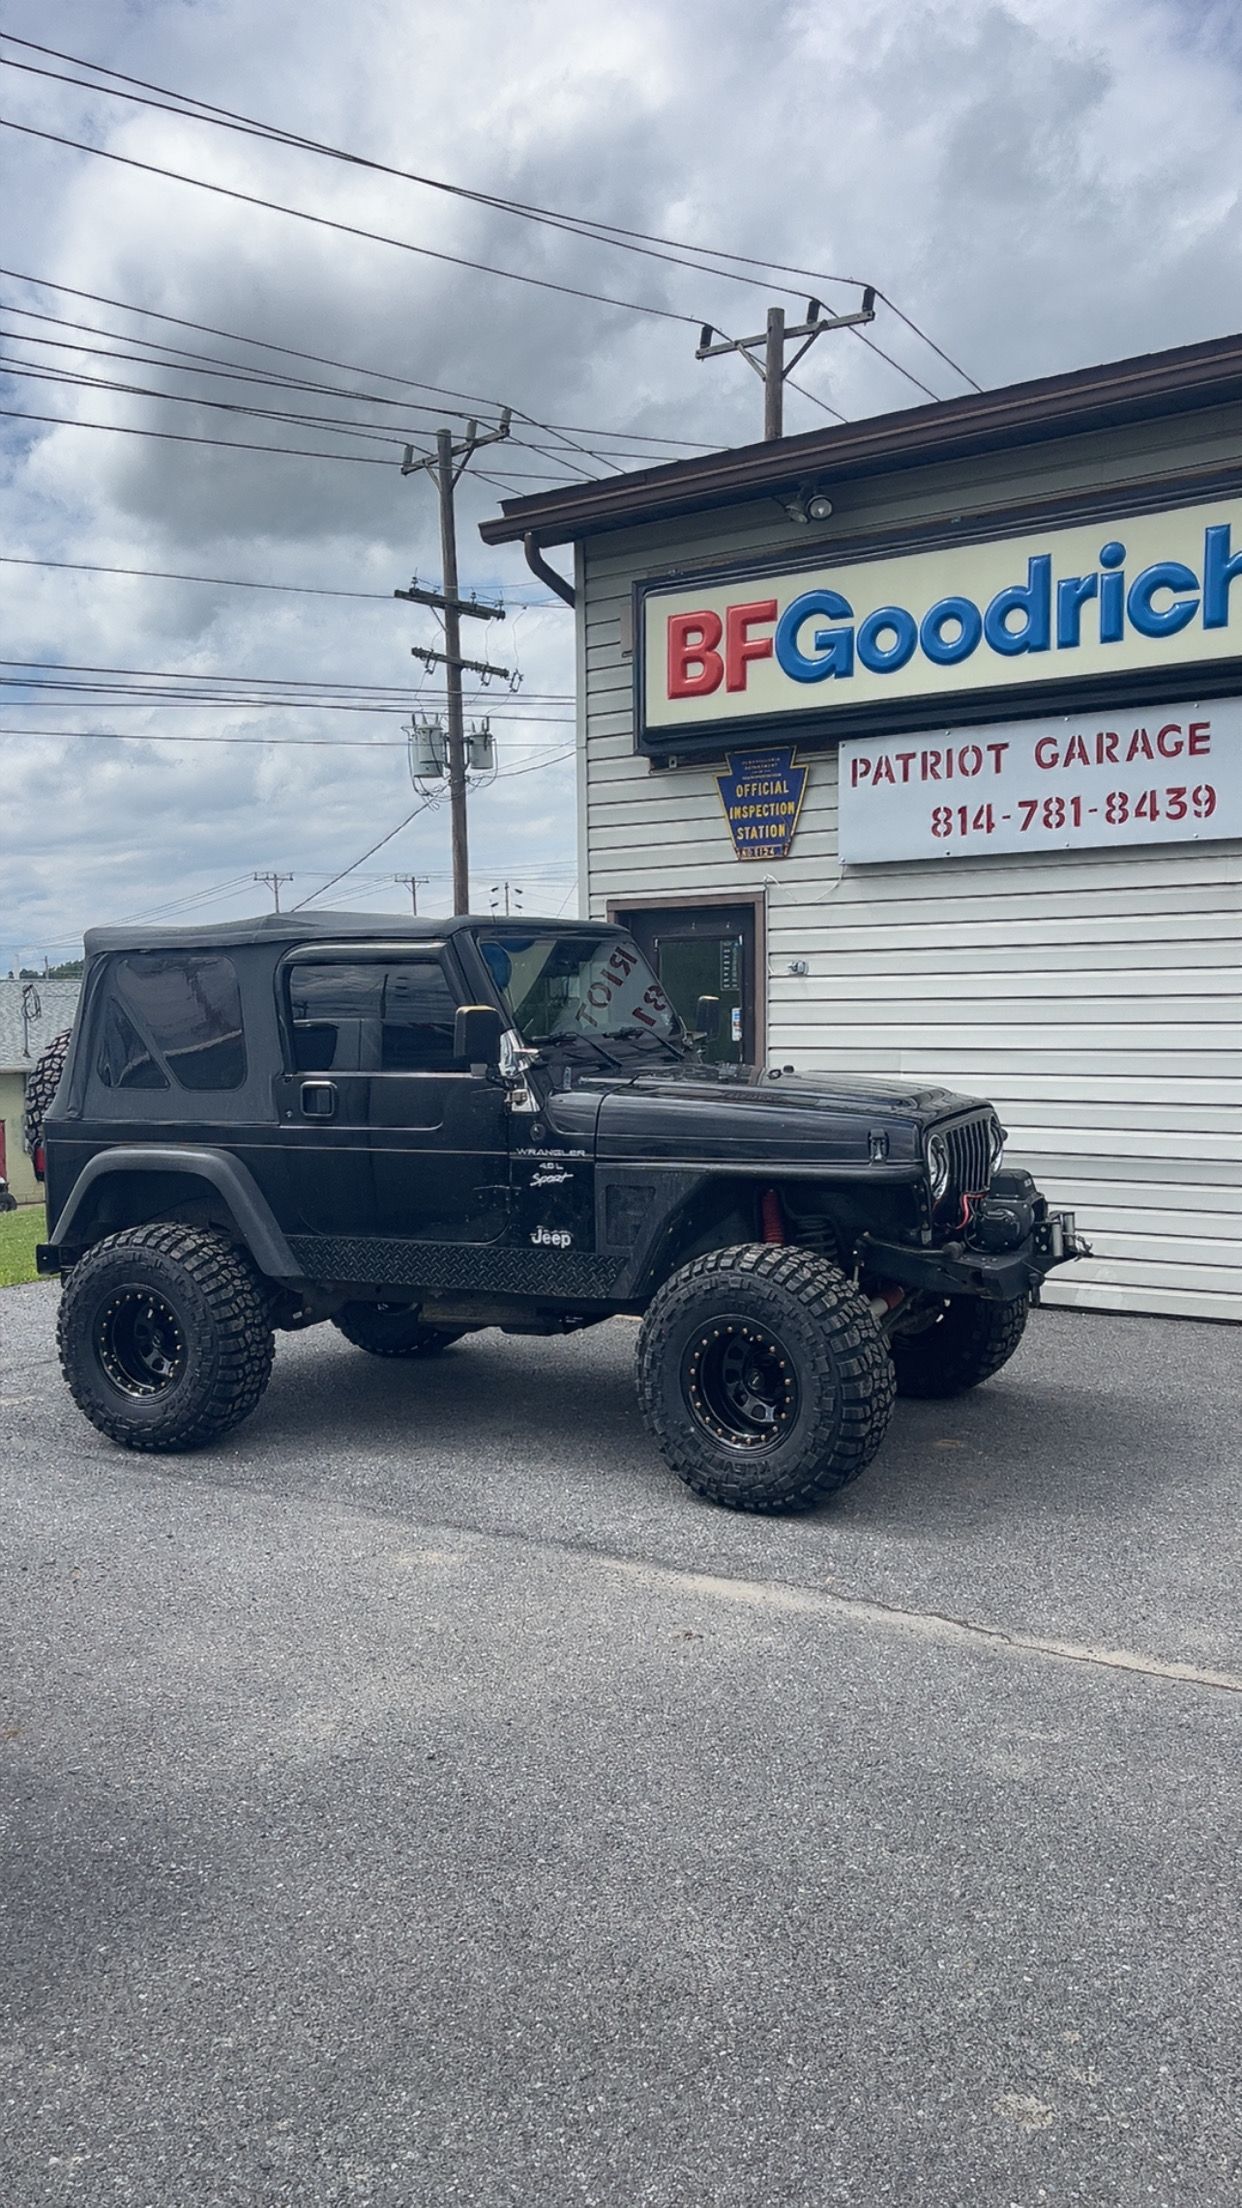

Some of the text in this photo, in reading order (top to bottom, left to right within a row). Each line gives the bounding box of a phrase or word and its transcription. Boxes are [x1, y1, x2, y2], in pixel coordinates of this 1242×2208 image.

[667, 523, 1242, 700] BFGoodrich
[851, 721, 1211, 788] PATRIOT GARAGE
[736, 780, 789, 797] OFFICIAL
[729, 802, 795, 819] INSPECTION
[931, 784, 1217, 838] 814-781-8439
[736, 824, 786, 839] STATION
[516, 1147, 586, 1157] WRANGLER
[529, 1172, 574, 1187] Sport
[529, 1225, 573, 1249] Jeep
